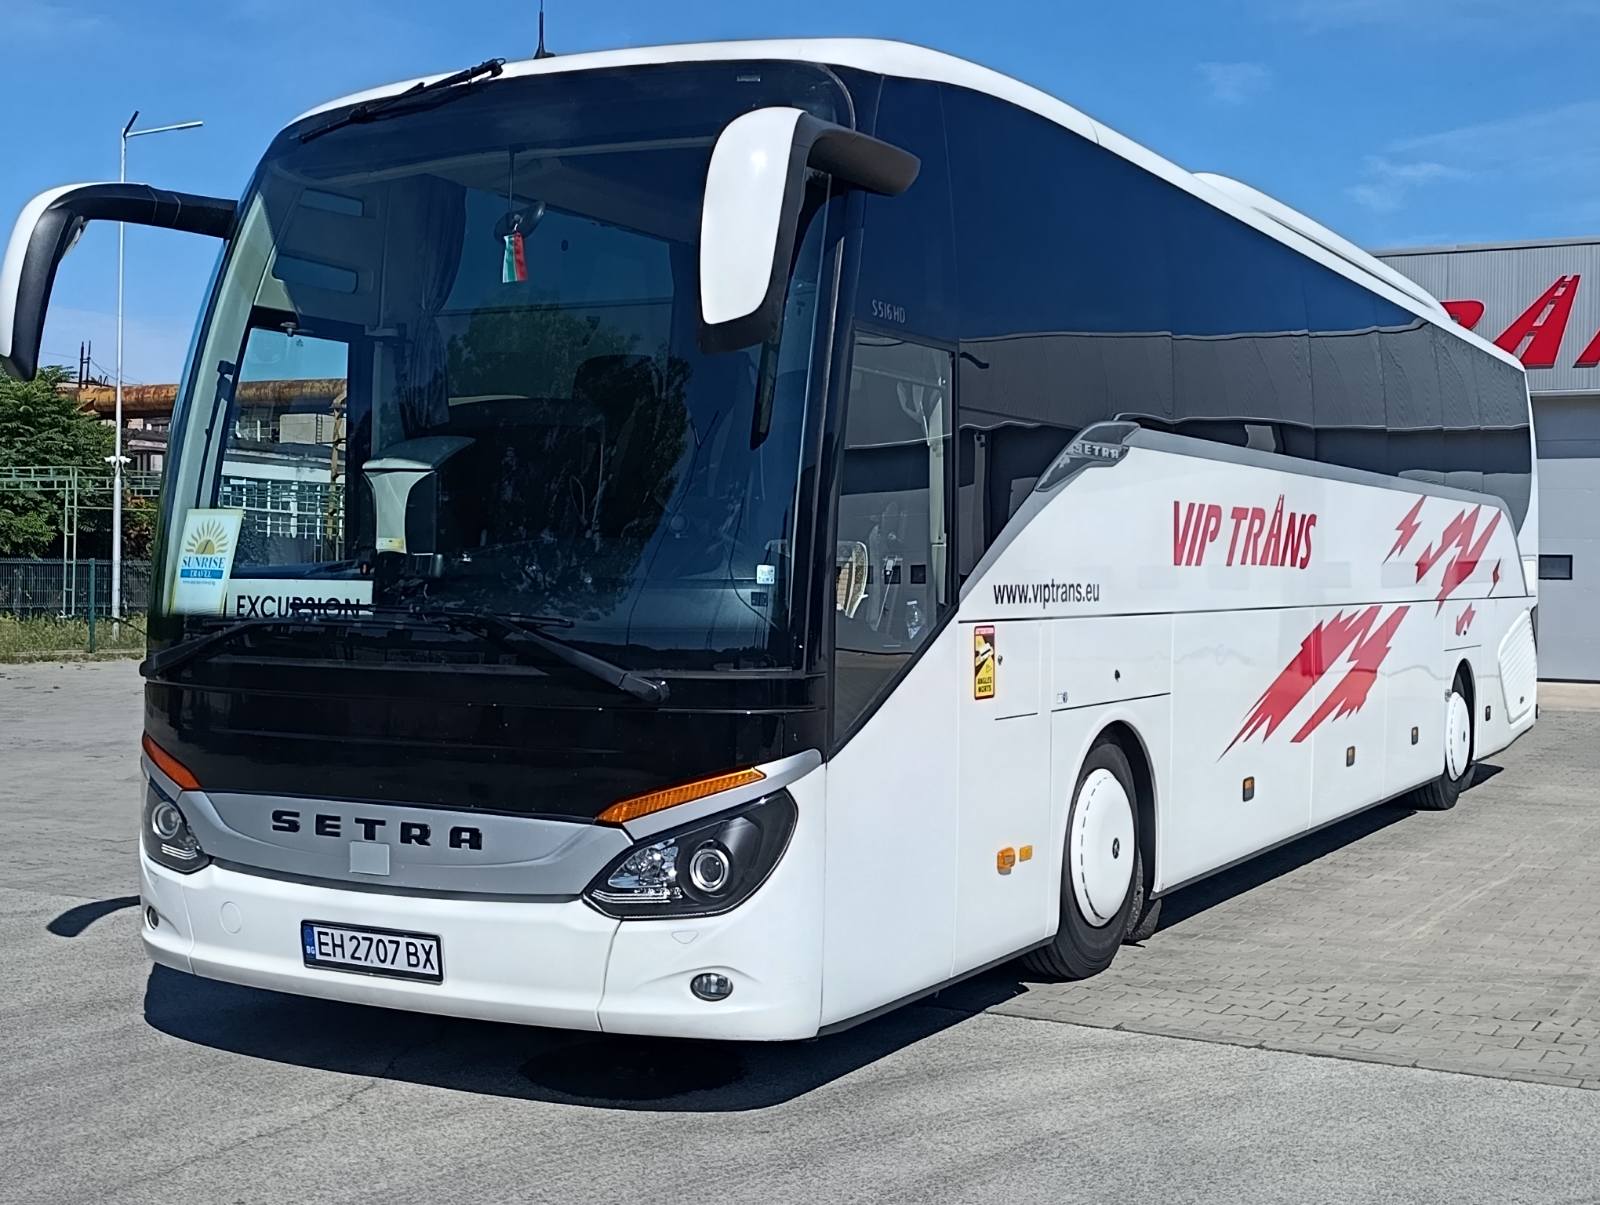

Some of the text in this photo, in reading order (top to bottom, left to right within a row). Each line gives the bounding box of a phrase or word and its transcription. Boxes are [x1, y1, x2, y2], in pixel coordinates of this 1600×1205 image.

[1173, 494, 1317, 570] VIP TRANS
[181, 556, 226, 569] SUNRISE
[993, 578, 1100, 609] www.viptrans.eu
[271, 809, 483, 850] SETRA
[317, 931, 436, 971] EH 2707 BX
